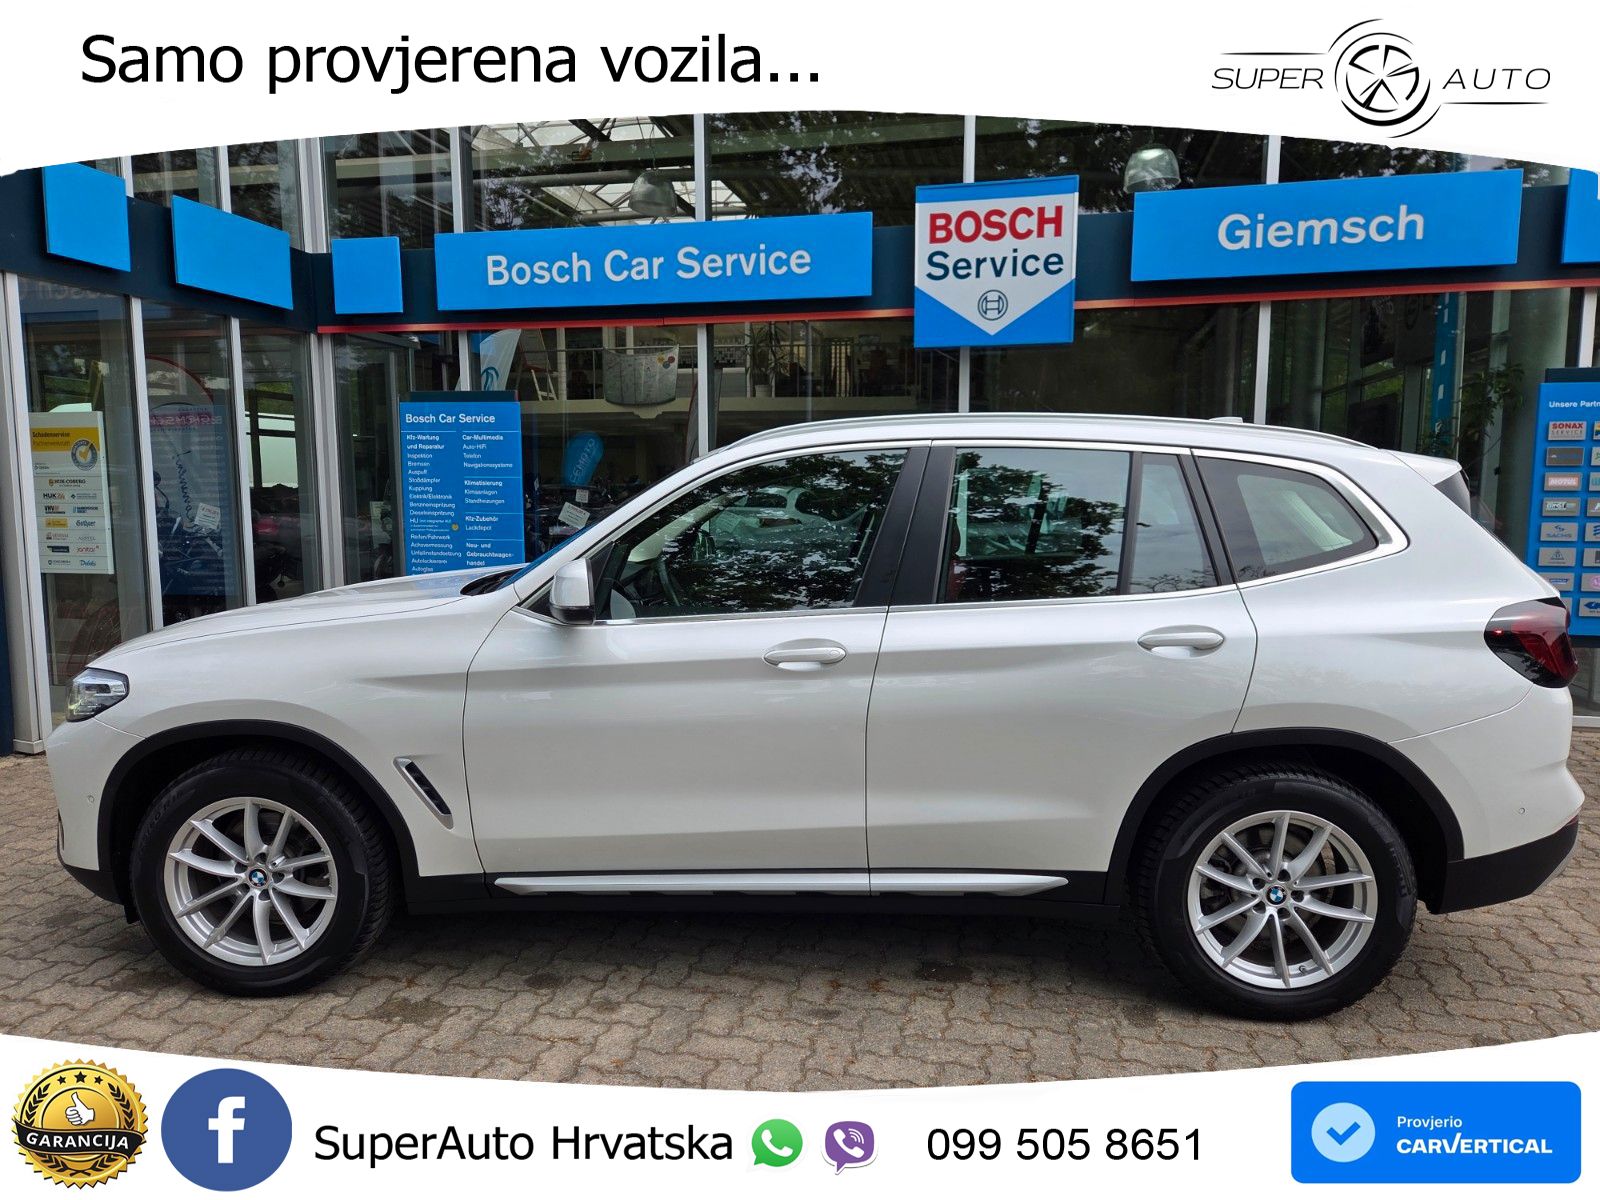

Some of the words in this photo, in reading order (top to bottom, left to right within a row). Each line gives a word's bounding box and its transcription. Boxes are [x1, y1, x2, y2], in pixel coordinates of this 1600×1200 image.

[929, 205, 1063, 244] BOSCH
[1218, 204, 1424, 251] Giemsch
[487, 252, 591, 286] Bosch
[604, 249, 664, 282] Car
[676, 243, 811, 279] Service
[926, 248, 1064, 281] Service
[1580, 400, 1600, 408] Partn
[405, 413, 436, 423] Bosch
[439, 413, 456, 423] Car
[458, 413, 496, 423] Service
[1551, 422, 1583, 430] SONAX
[418, 443, 445, 451] Reparatur
[411, 550, 462, 558] Unfallinstandsetzung
